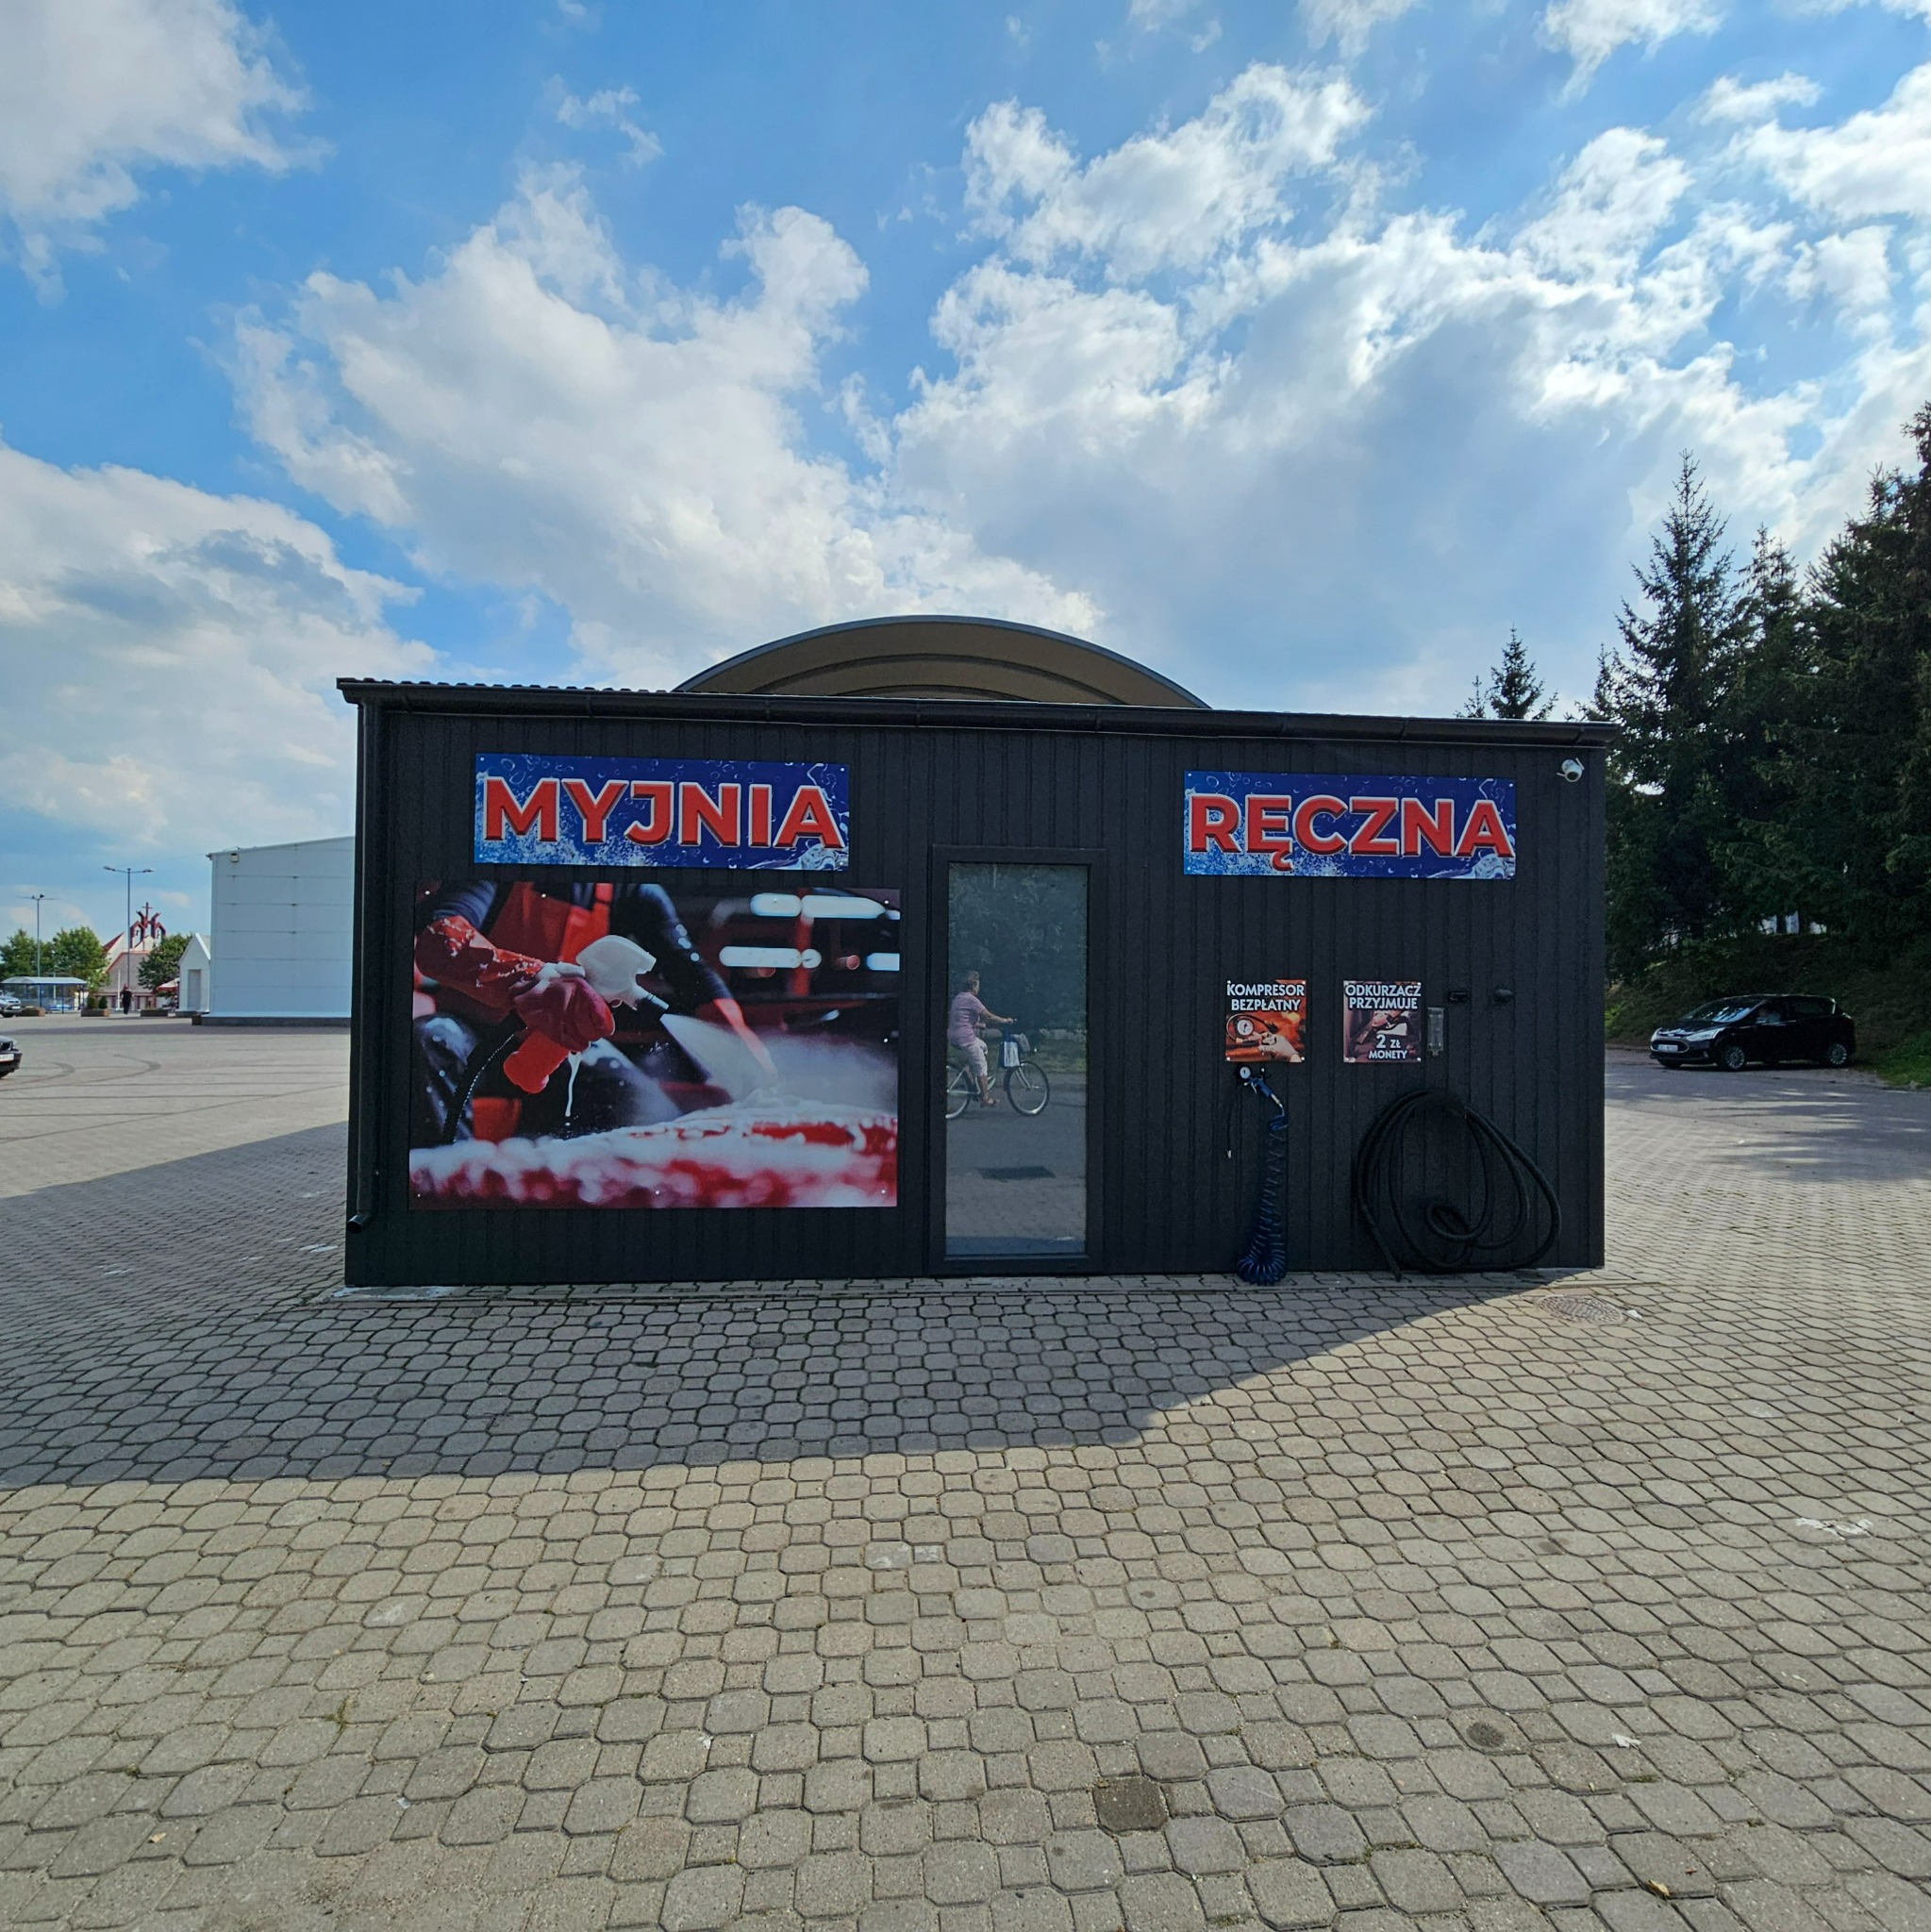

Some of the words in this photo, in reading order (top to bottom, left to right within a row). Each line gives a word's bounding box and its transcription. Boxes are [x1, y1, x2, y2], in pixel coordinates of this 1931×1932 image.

[483, 776, 845, 849] MYJNIA
[1190, 794, 1515, 872] RĘCZNA
[1226, 983, 1305, 996] KOMPRESOR
[1344, 984, 1422, 997] ODKURZACZ
[1231, 999, 1301, 1011] BEZPŁATNY
[1349, 997, 1418, 1009] PRZYJMUJE
[1375, 1034, 1387, 1049] 2
[1390, 1039, 1401, 1049] ZŁ
[1368, 1050, 1407, 1059] MONETY
